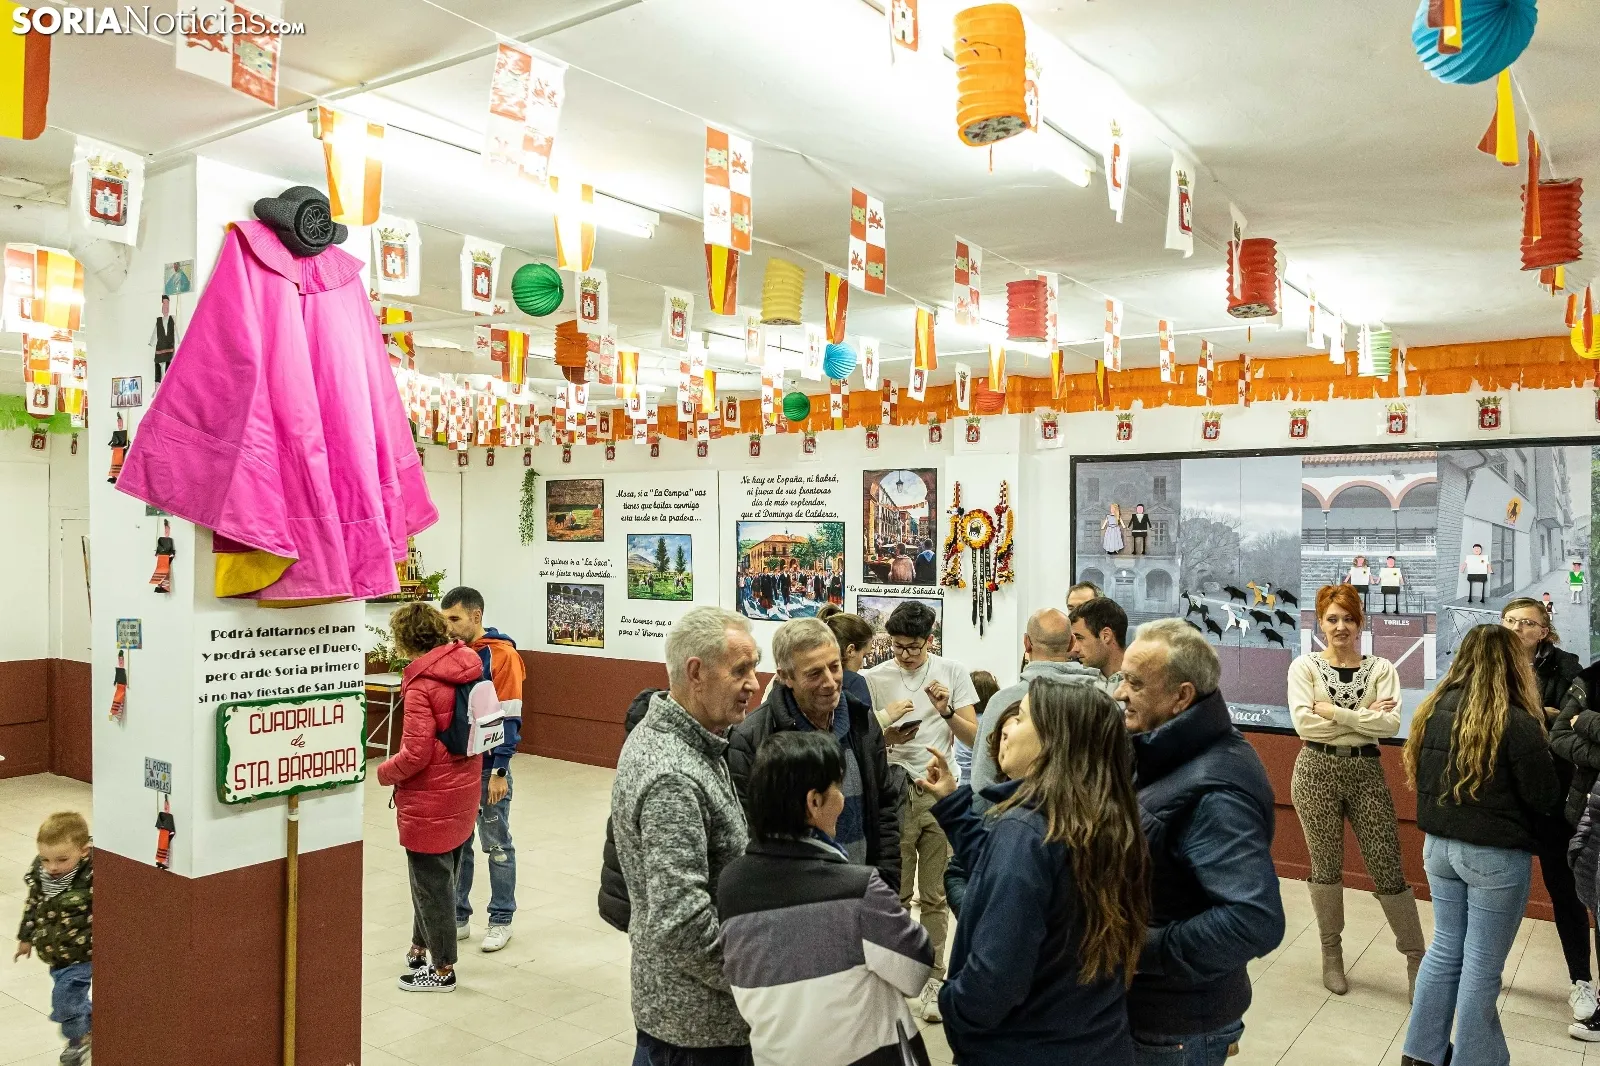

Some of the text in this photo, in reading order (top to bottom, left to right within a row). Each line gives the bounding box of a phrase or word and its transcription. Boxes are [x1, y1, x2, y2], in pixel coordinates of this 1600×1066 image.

[740, 476, 750, 484] No
[752, 476, 766, 486] hay
[776, 474, 804, 485] España,
[816, 474, 839, 483] habrá,
[650, 488, 662, 496] "La
[664, 488, 694, 498] Compra"
[755, 487, 774, 497] fuera
[776, 486, 783, 494] de
[798, 486, 832, 496] fronteras
[653, 501, 672, 509] bailar
[674, 502, 700, 510] conmigo
[752, 498, 763, 506] día
[790, 498, 826, 508] esplendor,
[634, 514, 650, 522] tarde
[668, 514, 702, 523] pradera...
[740, 512, 752, 520] que
[754, 510, 762, 518] el
[762, 509, 792, 520] Domingo
[795, 510, 803, 518] de
[572, 571, 584, 579] muy
[912, 586, 936, 594] Sábado
[211, 625, 355, 641] Podrá faltarnos el pan
[214, 649, 256, 661] podrá
[259, 646, 306, 658] secarse
[309, 645, 320, 655] el
[322, 643, 362, 654] Duero,
[206, 662, 360, 684] pero arde Soria primero
[198, 694, 208, 704] si
[212, 694, 227, 702] no
[257, 686, 294, 698] fiestas
[298, 684, 311, 693] de
[314, 682, 334, 692] San
[338, 680, 364, 690] Juan
[250, 704, 344, 734] CUADRILLA
[290, 734, 306, 748] de
[234, 748, 356, 790] STA. BÁRBARA
